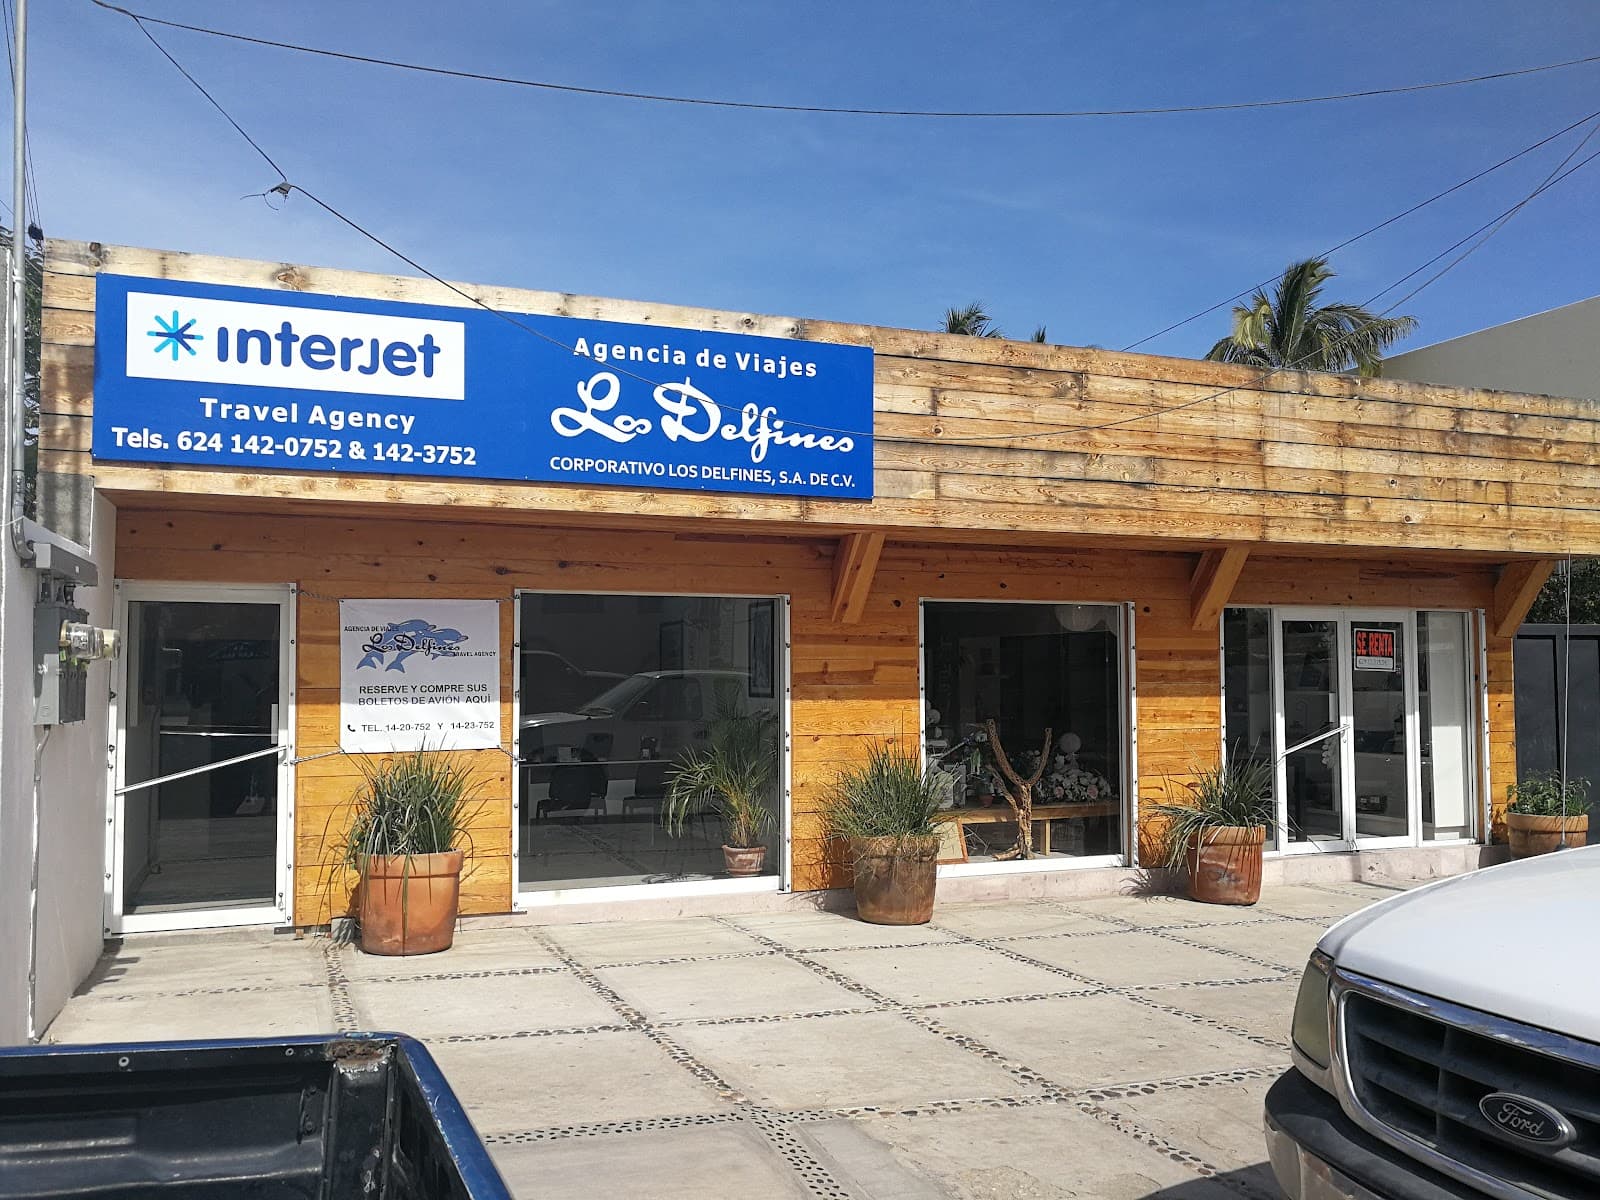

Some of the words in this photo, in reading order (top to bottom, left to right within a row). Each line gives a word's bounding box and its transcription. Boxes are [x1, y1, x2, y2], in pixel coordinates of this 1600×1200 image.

[217, 321, 441, 378] interjet
[573, 337, 686, 366] Agencia
[696, 349, 727, 369] de
[735, 352, 817, 379] Viajes
[199, 397, 298, 424] Travel
[308, 405, 415, 434] Agency
[550, 371, 652, 443] Los
[653, 376, 855, 463] Delfines
[111, 426, 169, 450] Tels.
[177, 431, 222, 453] 624
[231, 433, 342, 459] 142-0752
[349, 440, 366, 460] &
[373, 442, 477, 466] 142-3752
[550, 456, 665, 477] CORPORATIVO
[668, 463, 698, 479] LOS
[701, 465, 776, 486] DELFINES,
[779, 471, 807, 485] S.A.
[810, 473, 829, 487] DE
[831, 473, 856, 488] C.V.
[393, 631, 460, 657] Delfines
[1356, 631, 1367, 656] SE
[1368, 632, 1393, 657] RENTA
[358, 697, 409, 706] BOLETOS
[411, 696, 426, 705] DE
[359, 685, 409, 694] RESERVE
[410, 685, 418, 693] Y
[420, 684, 465, 693] COMPRE
[467, 683, 488, 692] SUS
[361, 724, 383, 732] TEL.
[385, 723, 431, 731] 14-20-752
[437, 722, 444, 730] Y
[450, 721, 495, 729] 14-23-752
[1497, 1102, 1545, 1136] Ford
